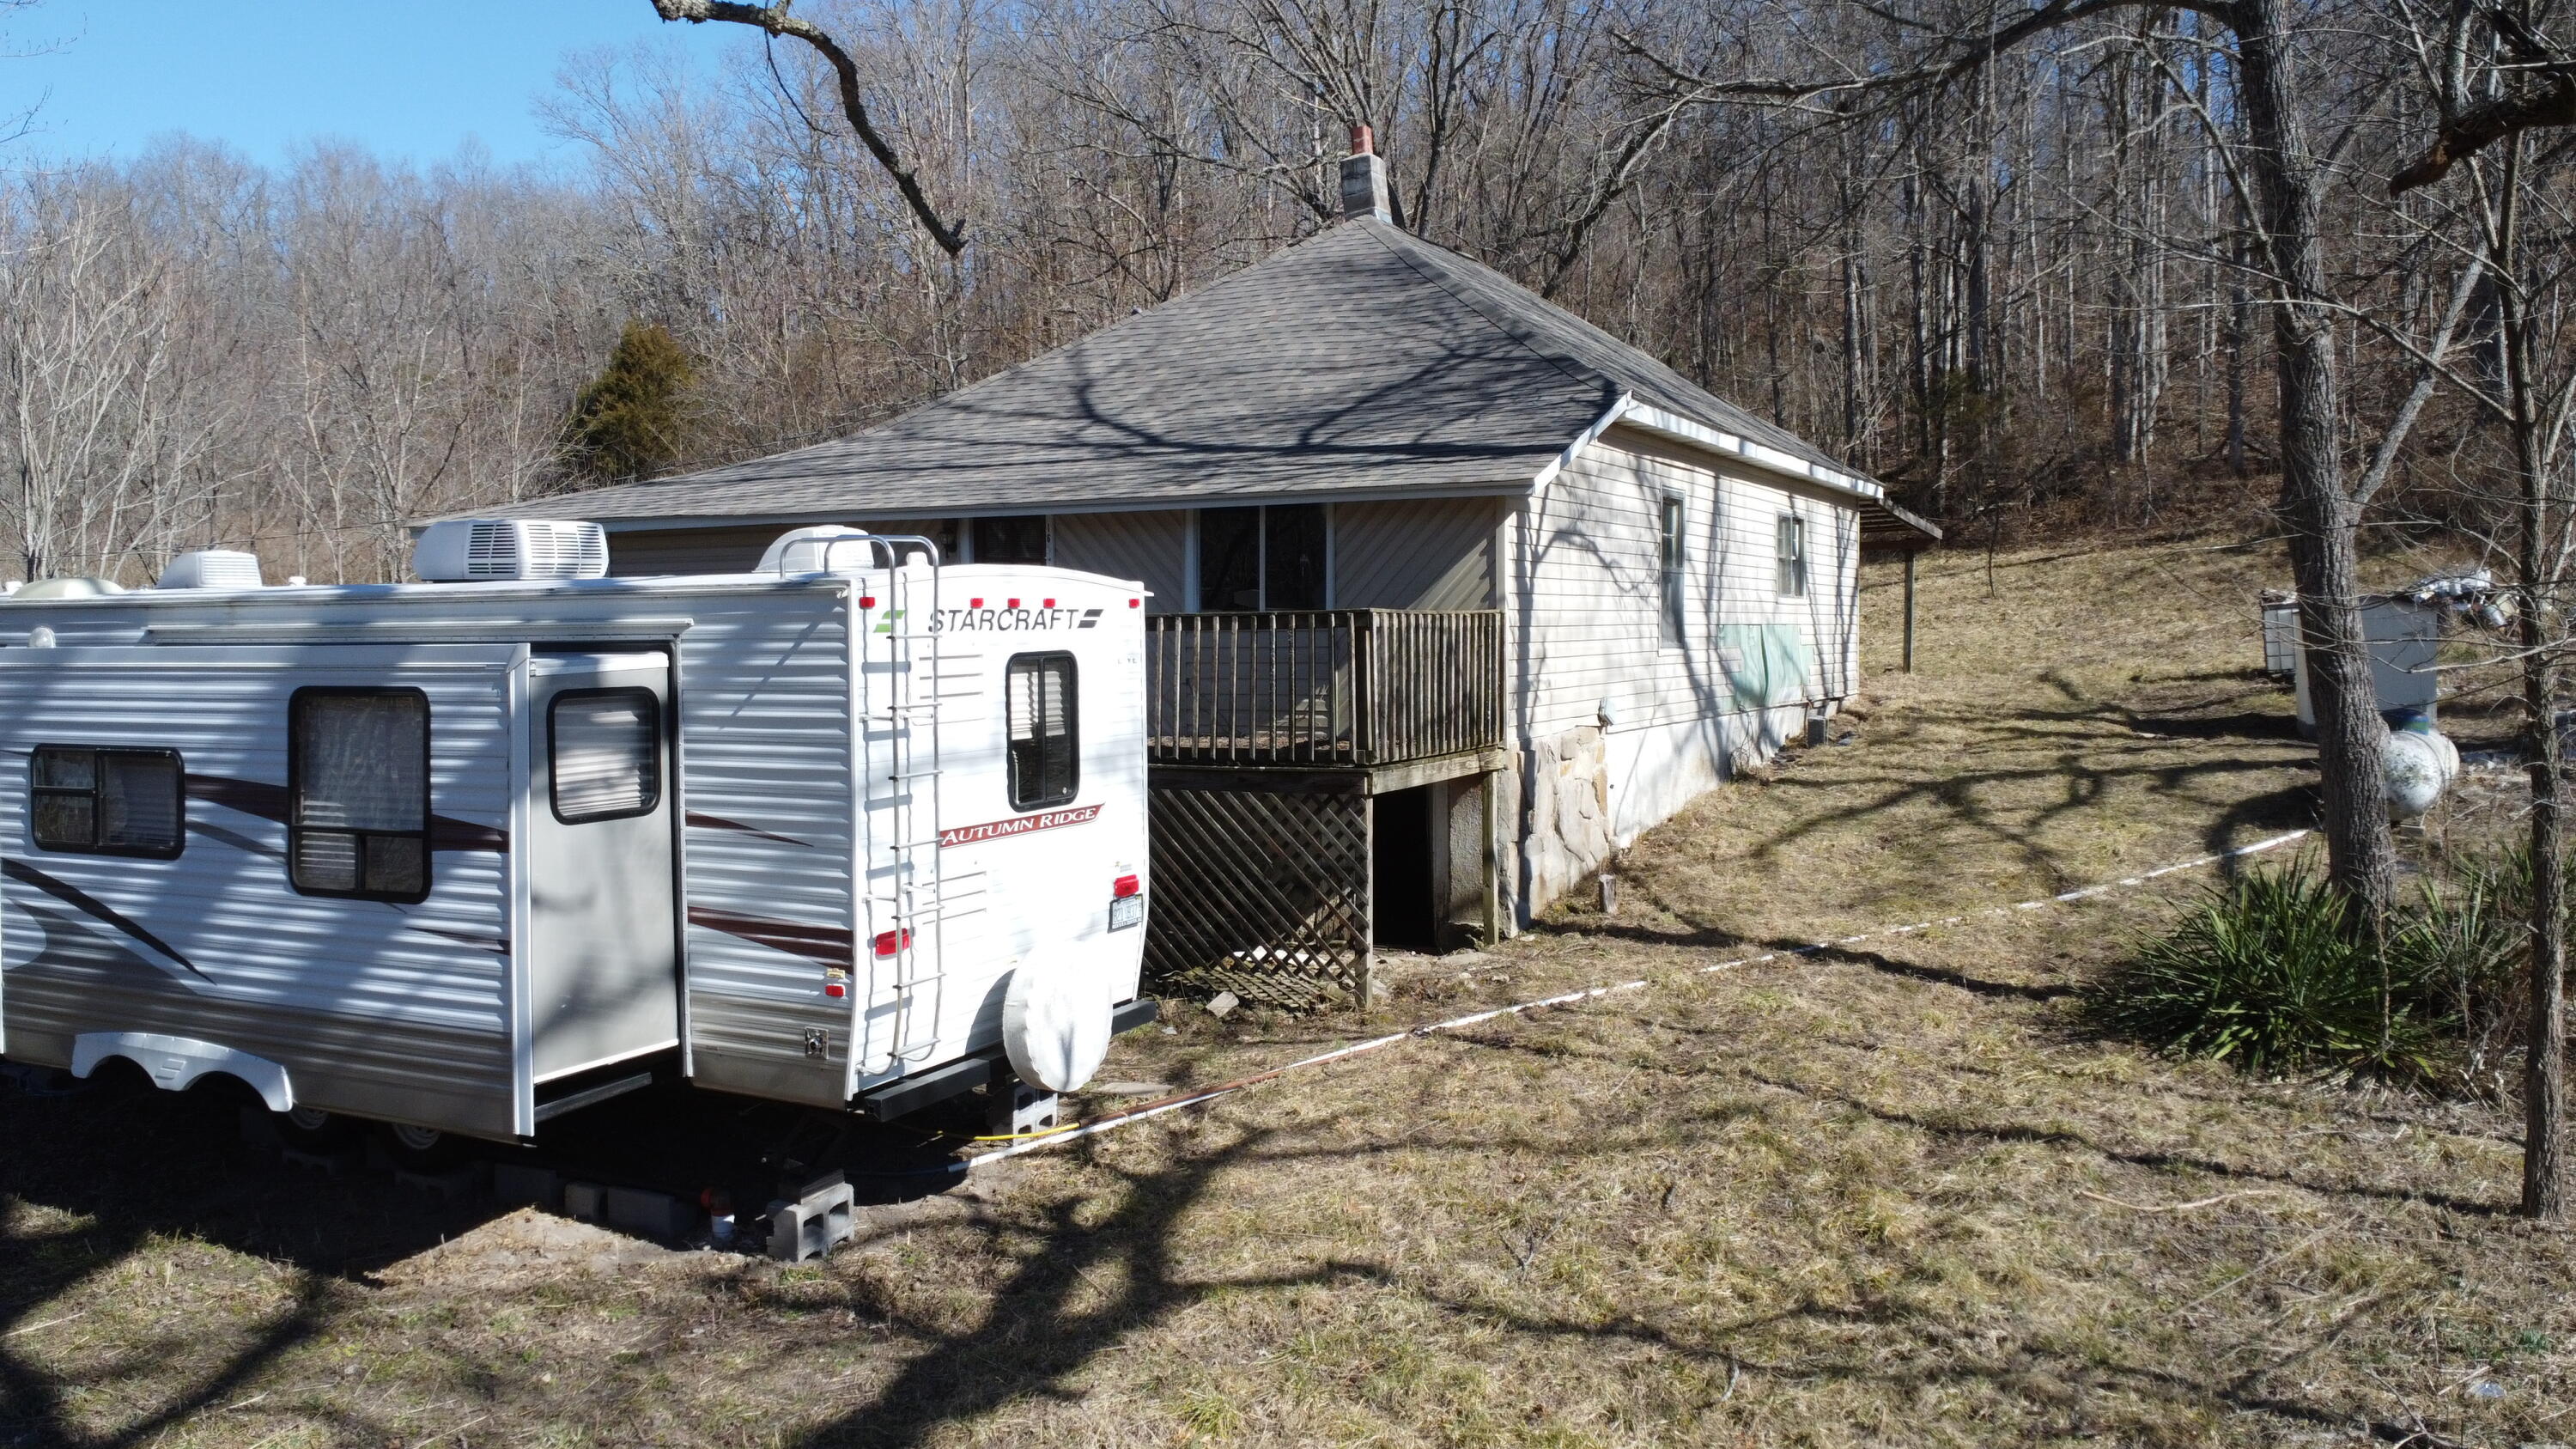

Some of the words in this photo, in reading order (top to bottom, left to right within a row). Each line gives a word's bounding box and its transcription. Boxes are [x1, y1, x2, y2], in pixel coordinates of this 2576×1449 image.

[928, 608, 1078, 632] STARCRAFT
[942, 818, 1034, 846] AUTUMN
[1040, 807, 1097, 828] RIDGE
